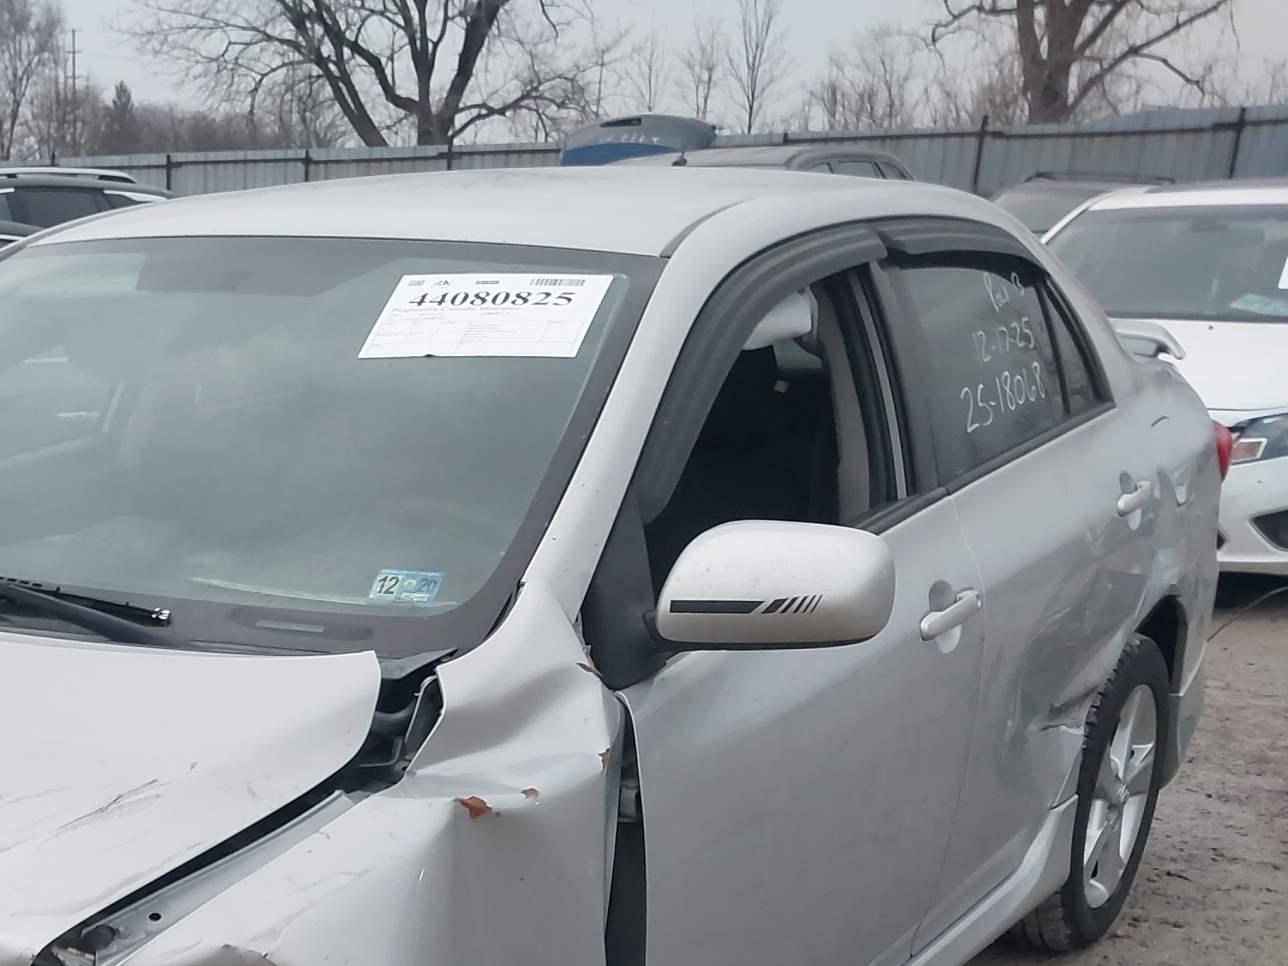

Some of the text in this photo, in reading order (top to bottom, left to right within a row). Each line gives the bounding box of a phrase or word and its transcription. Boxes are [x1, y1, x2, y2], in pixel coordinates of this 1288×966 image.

[408, 290, 576, 307] 44080825
[971, 316, 1035, 362] 12-17-25
[959, 360, 1046, 433] 25-18068
[377, 575, 399, 595] 12
